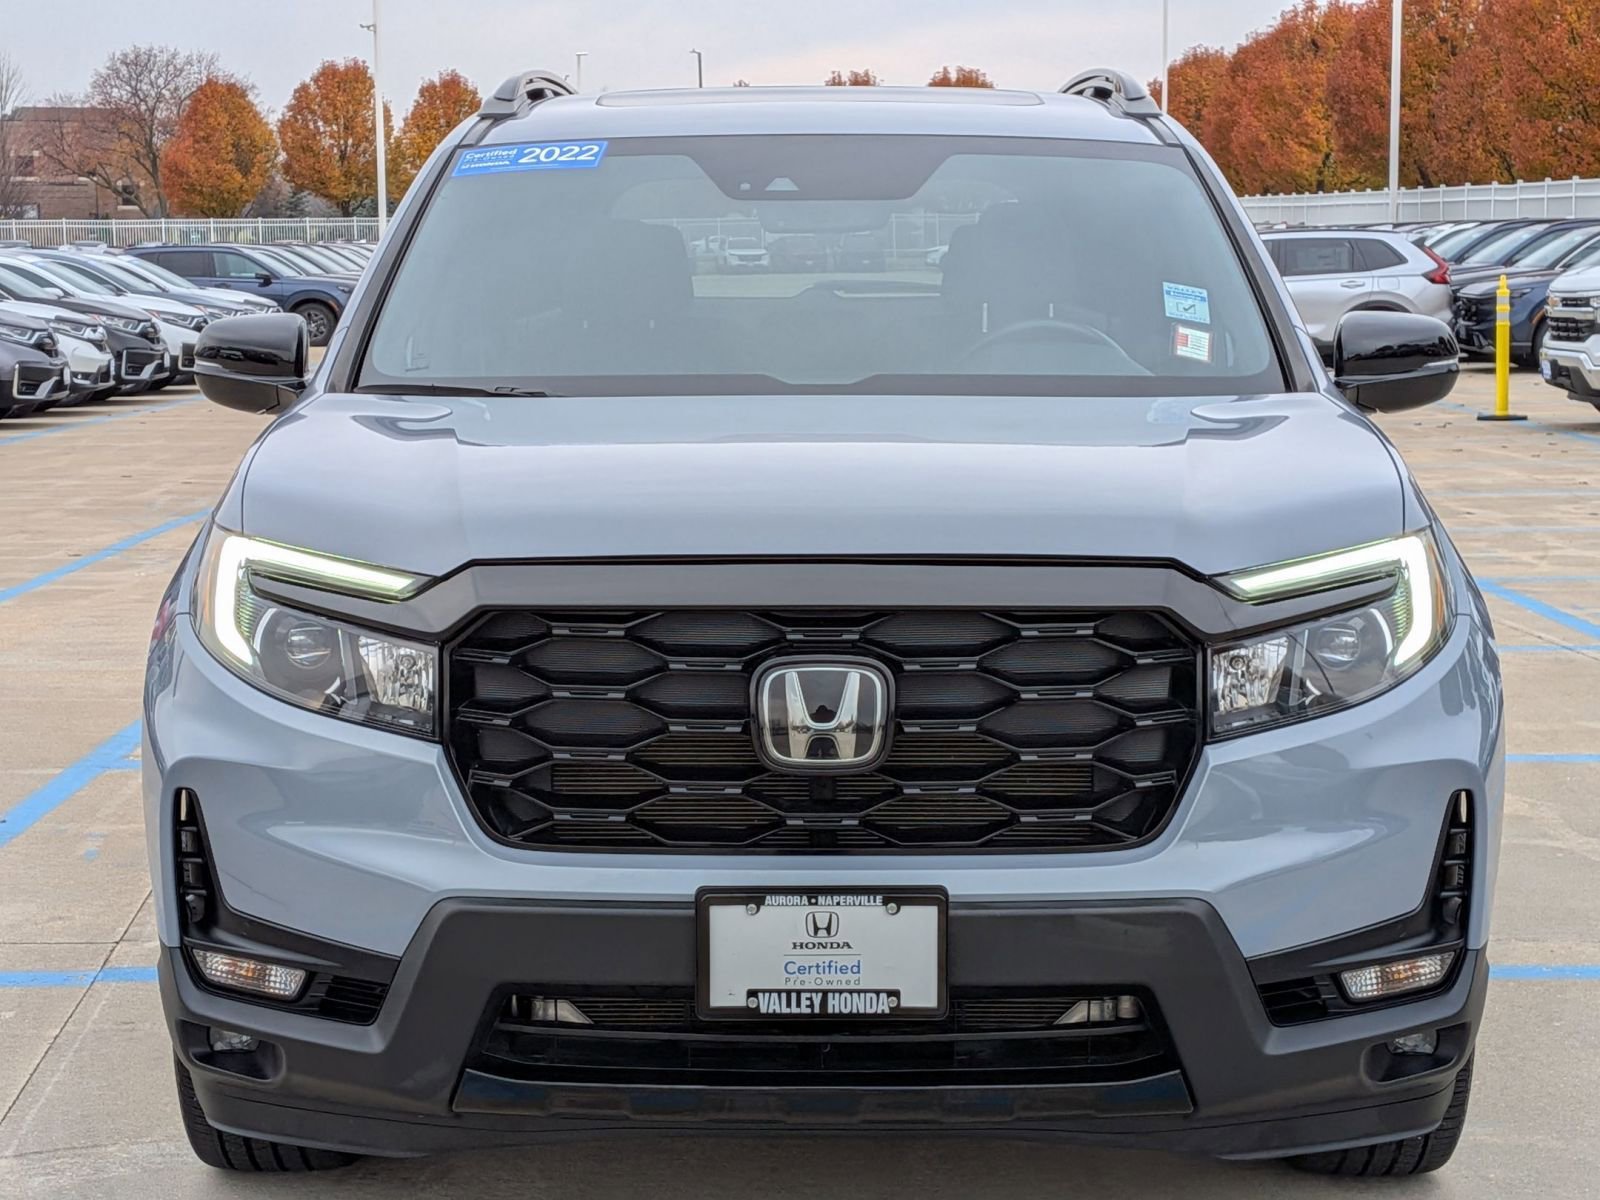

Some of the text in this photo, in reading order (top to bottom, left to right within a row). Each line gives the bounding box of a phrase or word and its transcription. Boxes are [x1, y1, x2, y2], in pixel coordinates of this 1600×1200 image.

[465, 148, 518, 159] Certified
[517, 144, 600, 163] 2022
[764, 895, 883, 906] AURORA NAPERVILLE
[791, 941, 853, 950] HONDA
[784, 960, 861, 975] Certified
[784, 976, 861, 986] Pre-Owned
[757, 991, 890, 1014] VALLEY HONDA
